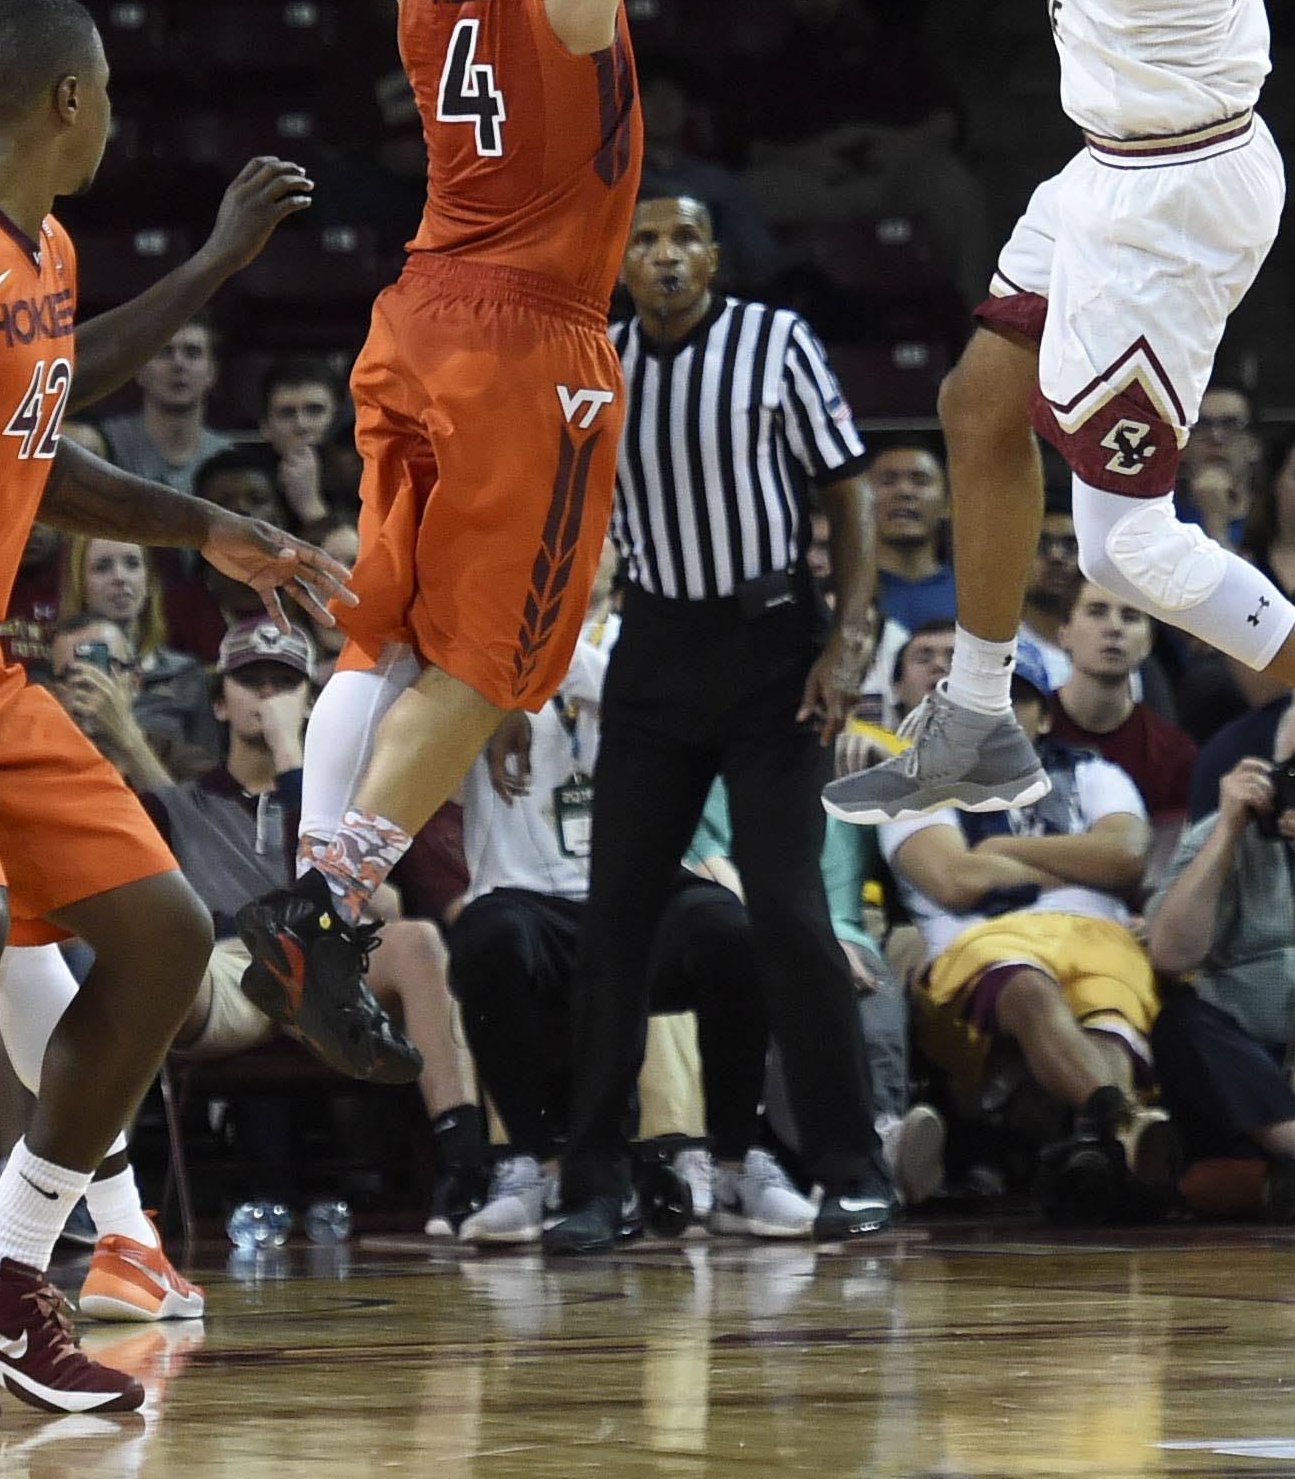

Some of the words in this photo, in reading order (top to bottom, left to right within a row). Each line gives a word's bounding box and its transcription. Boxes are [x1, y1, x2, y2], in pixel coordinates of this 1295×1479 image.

[436, 18, 506, 157] 4
[2, 358, 73, 459] 42
[555, 384, 614, 429] VT
